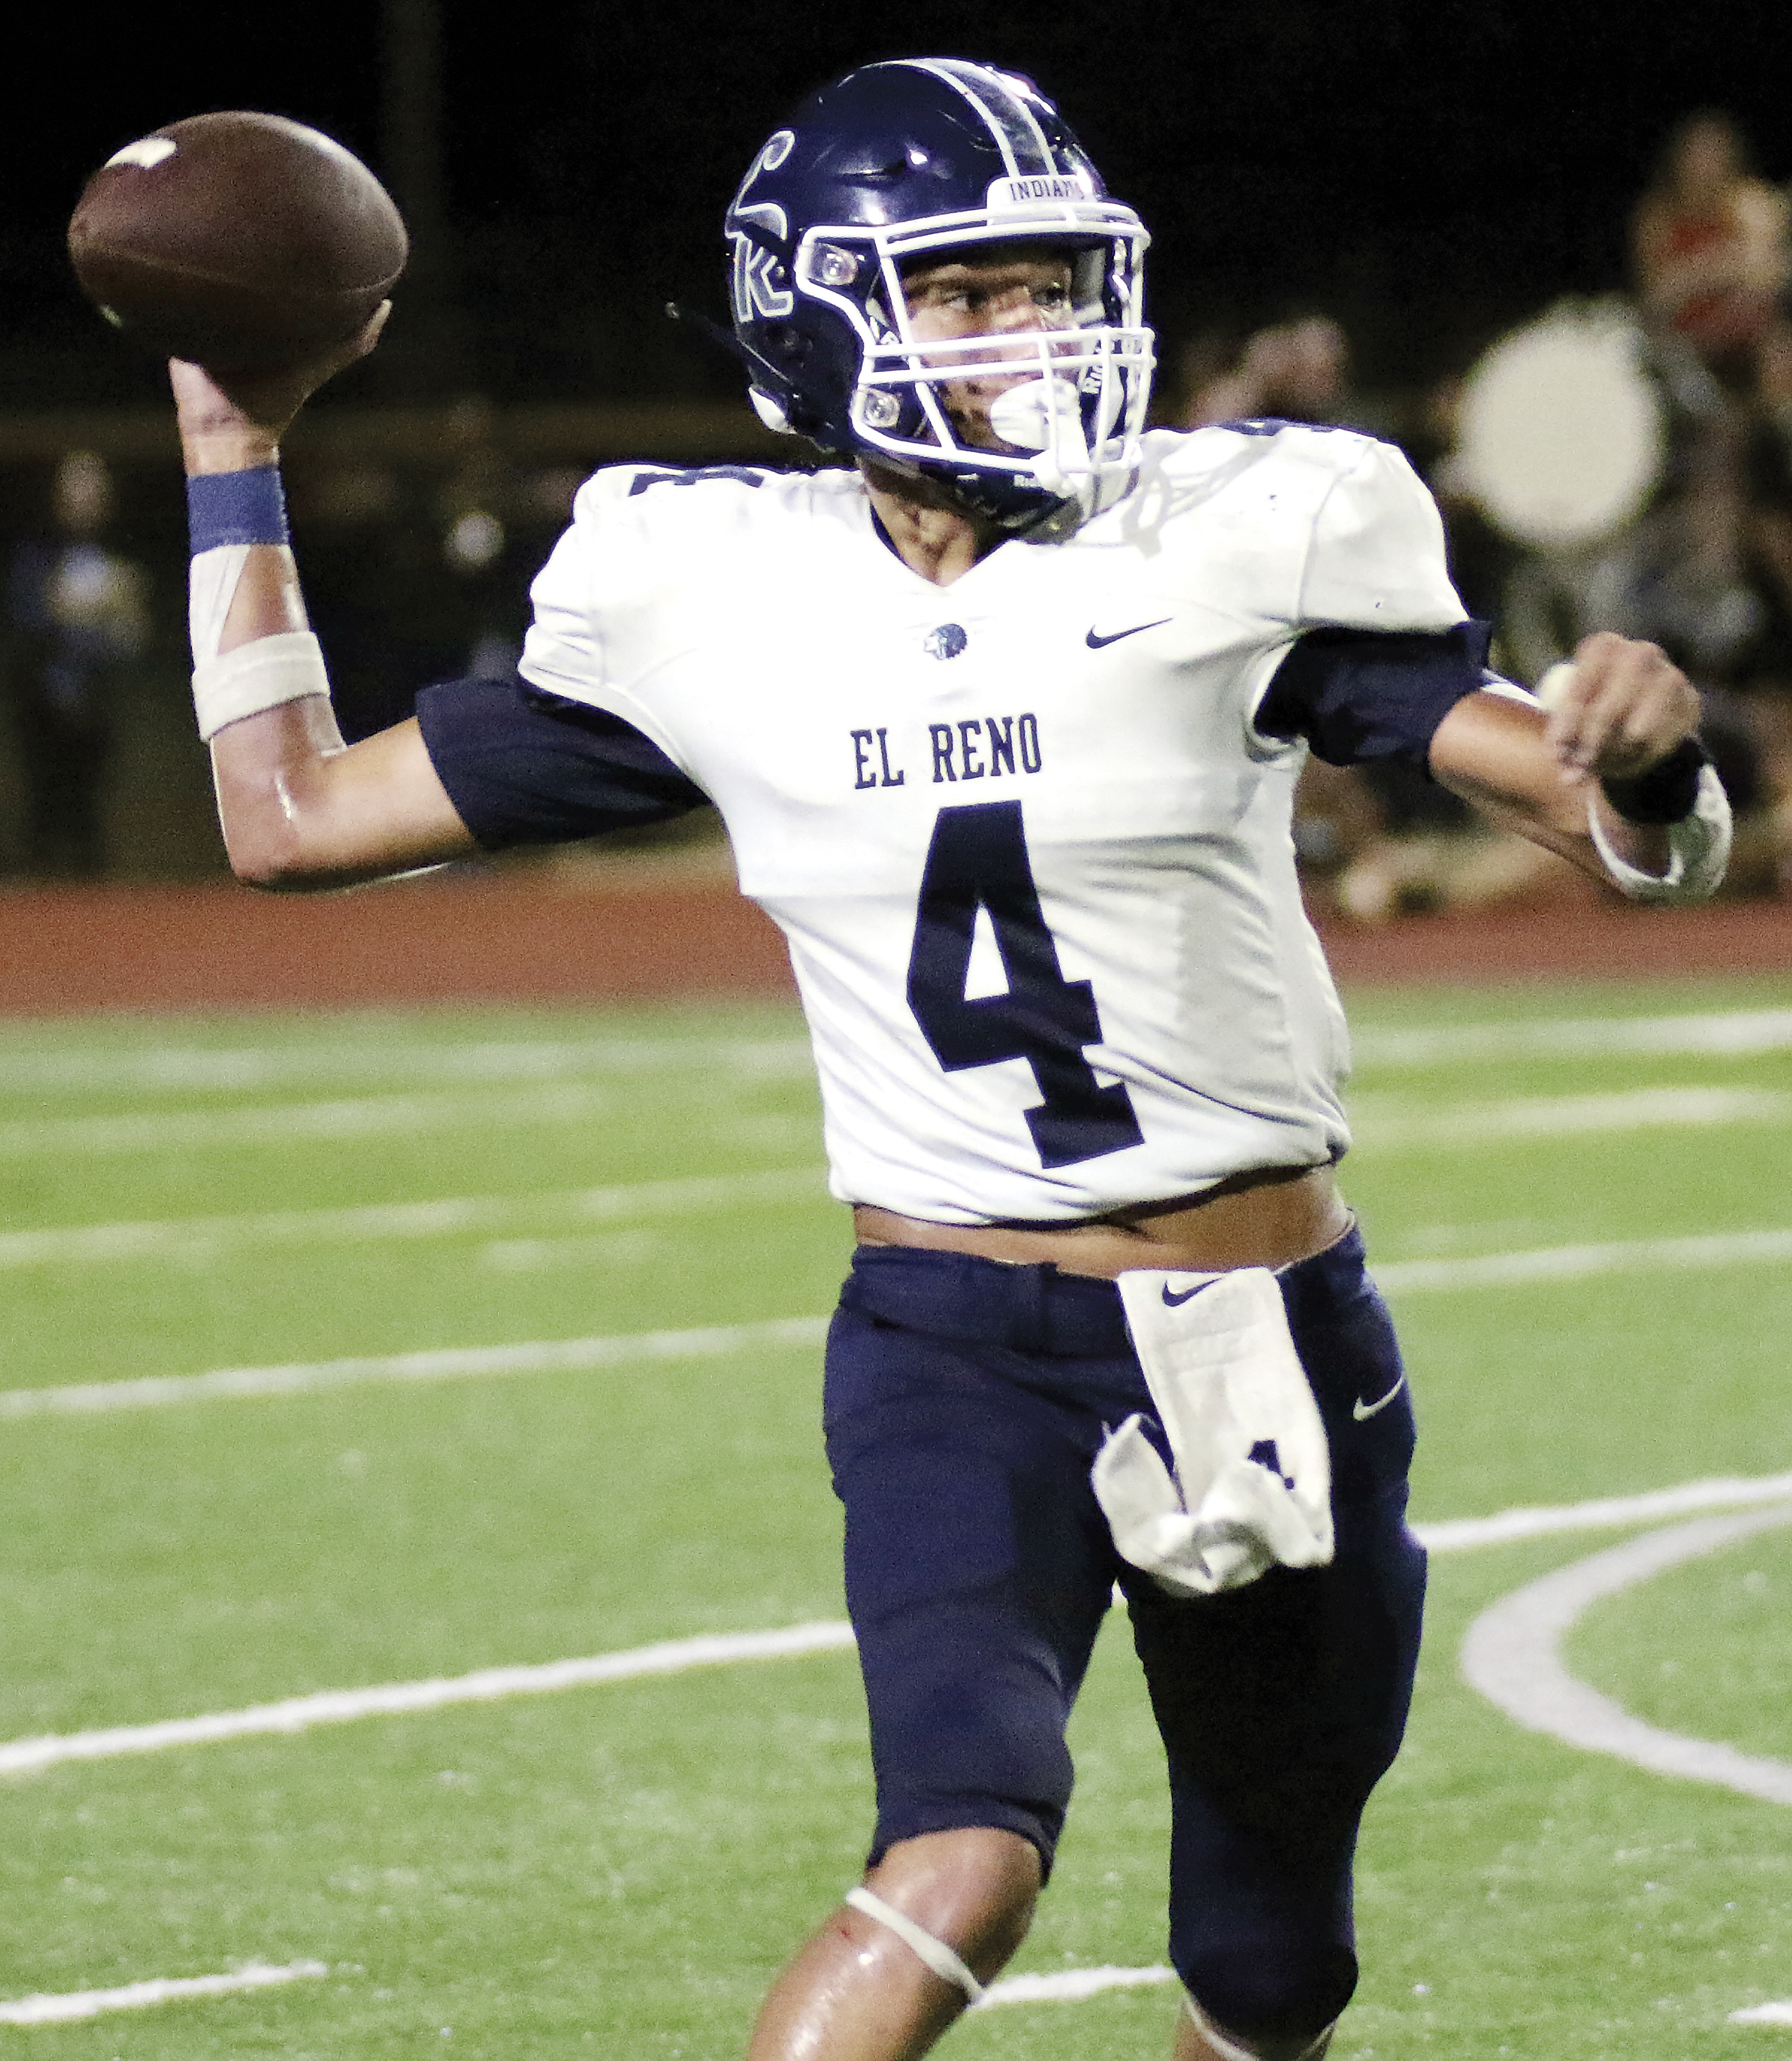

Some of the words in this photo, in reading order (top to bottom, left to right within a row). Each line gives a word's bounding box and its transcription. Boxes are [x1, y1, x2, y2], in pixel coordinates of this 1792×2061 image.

[850, 727, 904, 789] EL
[929, 713, 1042, 783] RENO
[907, 799, 1145, 1169] 4
